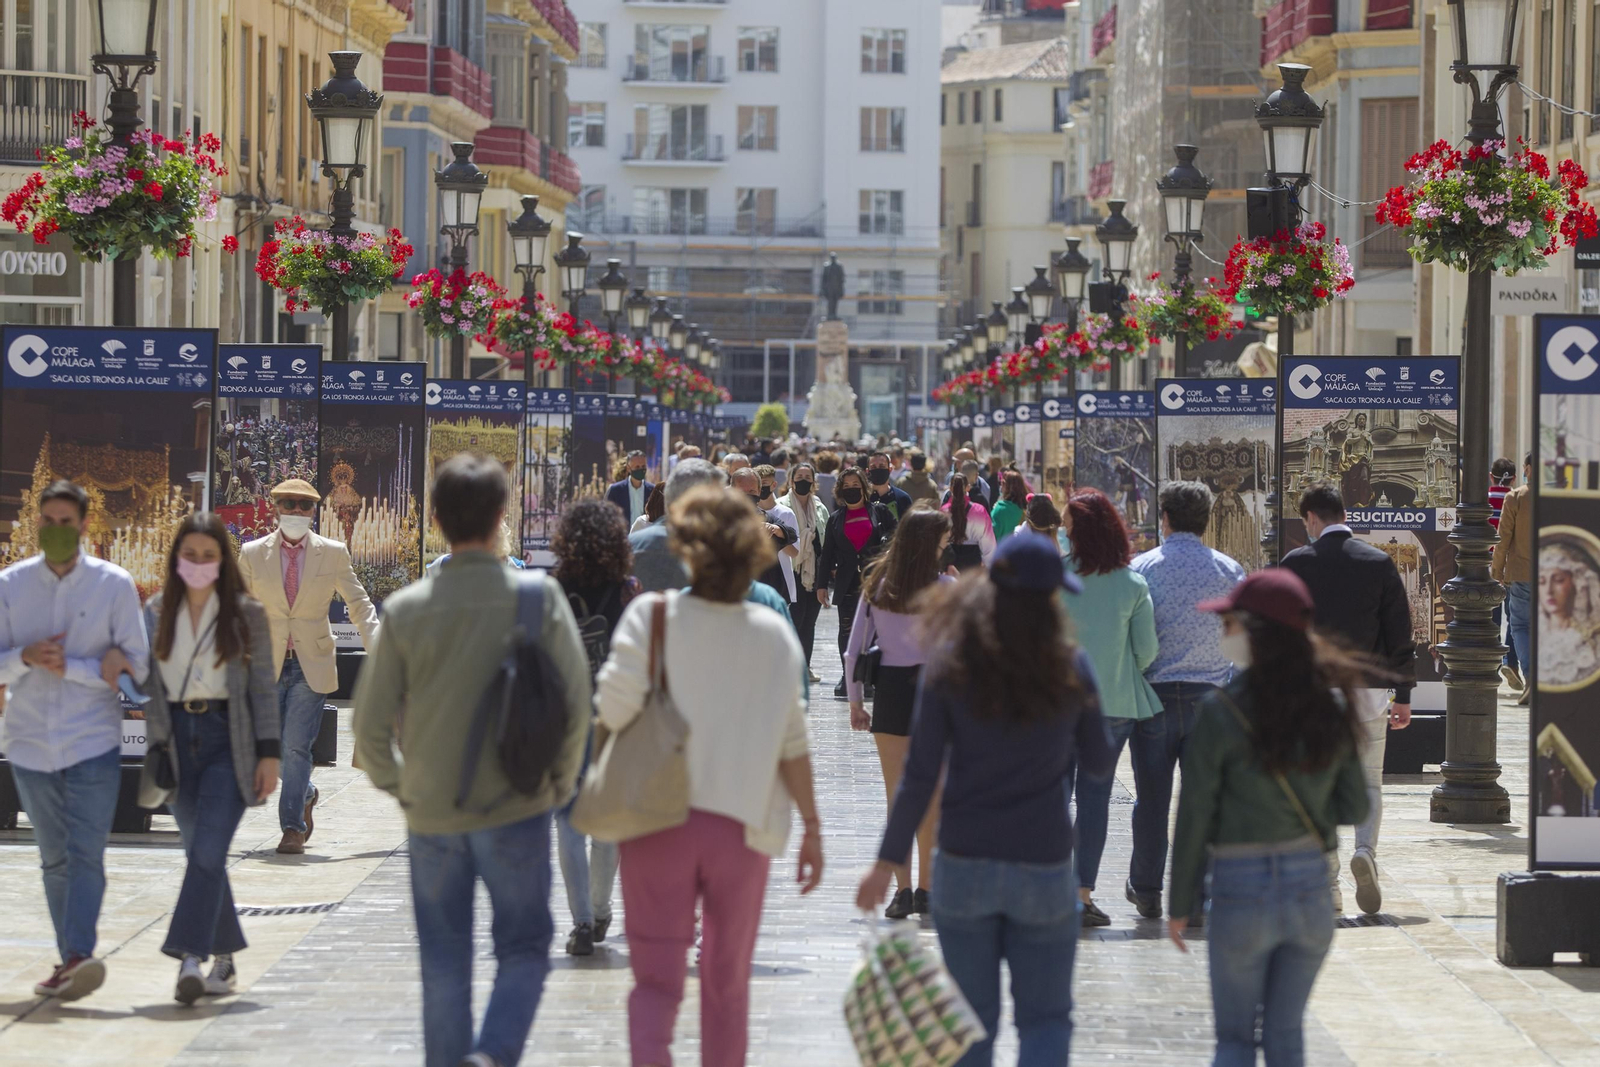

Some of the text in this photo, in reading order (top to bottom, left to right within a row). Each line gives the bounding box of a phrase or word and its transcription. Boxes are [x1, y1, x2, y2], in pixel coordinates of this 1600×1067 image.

[1577, 252, 1600, 261] CALZE
[0, 249, 67, 277] OYSHO
[52, 346, 79, 357] COPE
[51, 356, 96, 369] MÁLAGA
[75, 375, 91, 383] LOS
[92, 375, 125, 384] TRONOS
[126, 376, 134, 384] A
[135, 376, 145, 384] LA
[322, 375, 334, 383] OPE
[1324, 373, 1347, 382] COPE
[220, 385, 247, 393] TRONOS
[322, 381, 345, 390] ÁLAGA
[1324, 381, 1361, 391] MÁLAGA
[1346, 511, 1427, 523] ESUCITADO
[122, 735, 147, 745] UTO
